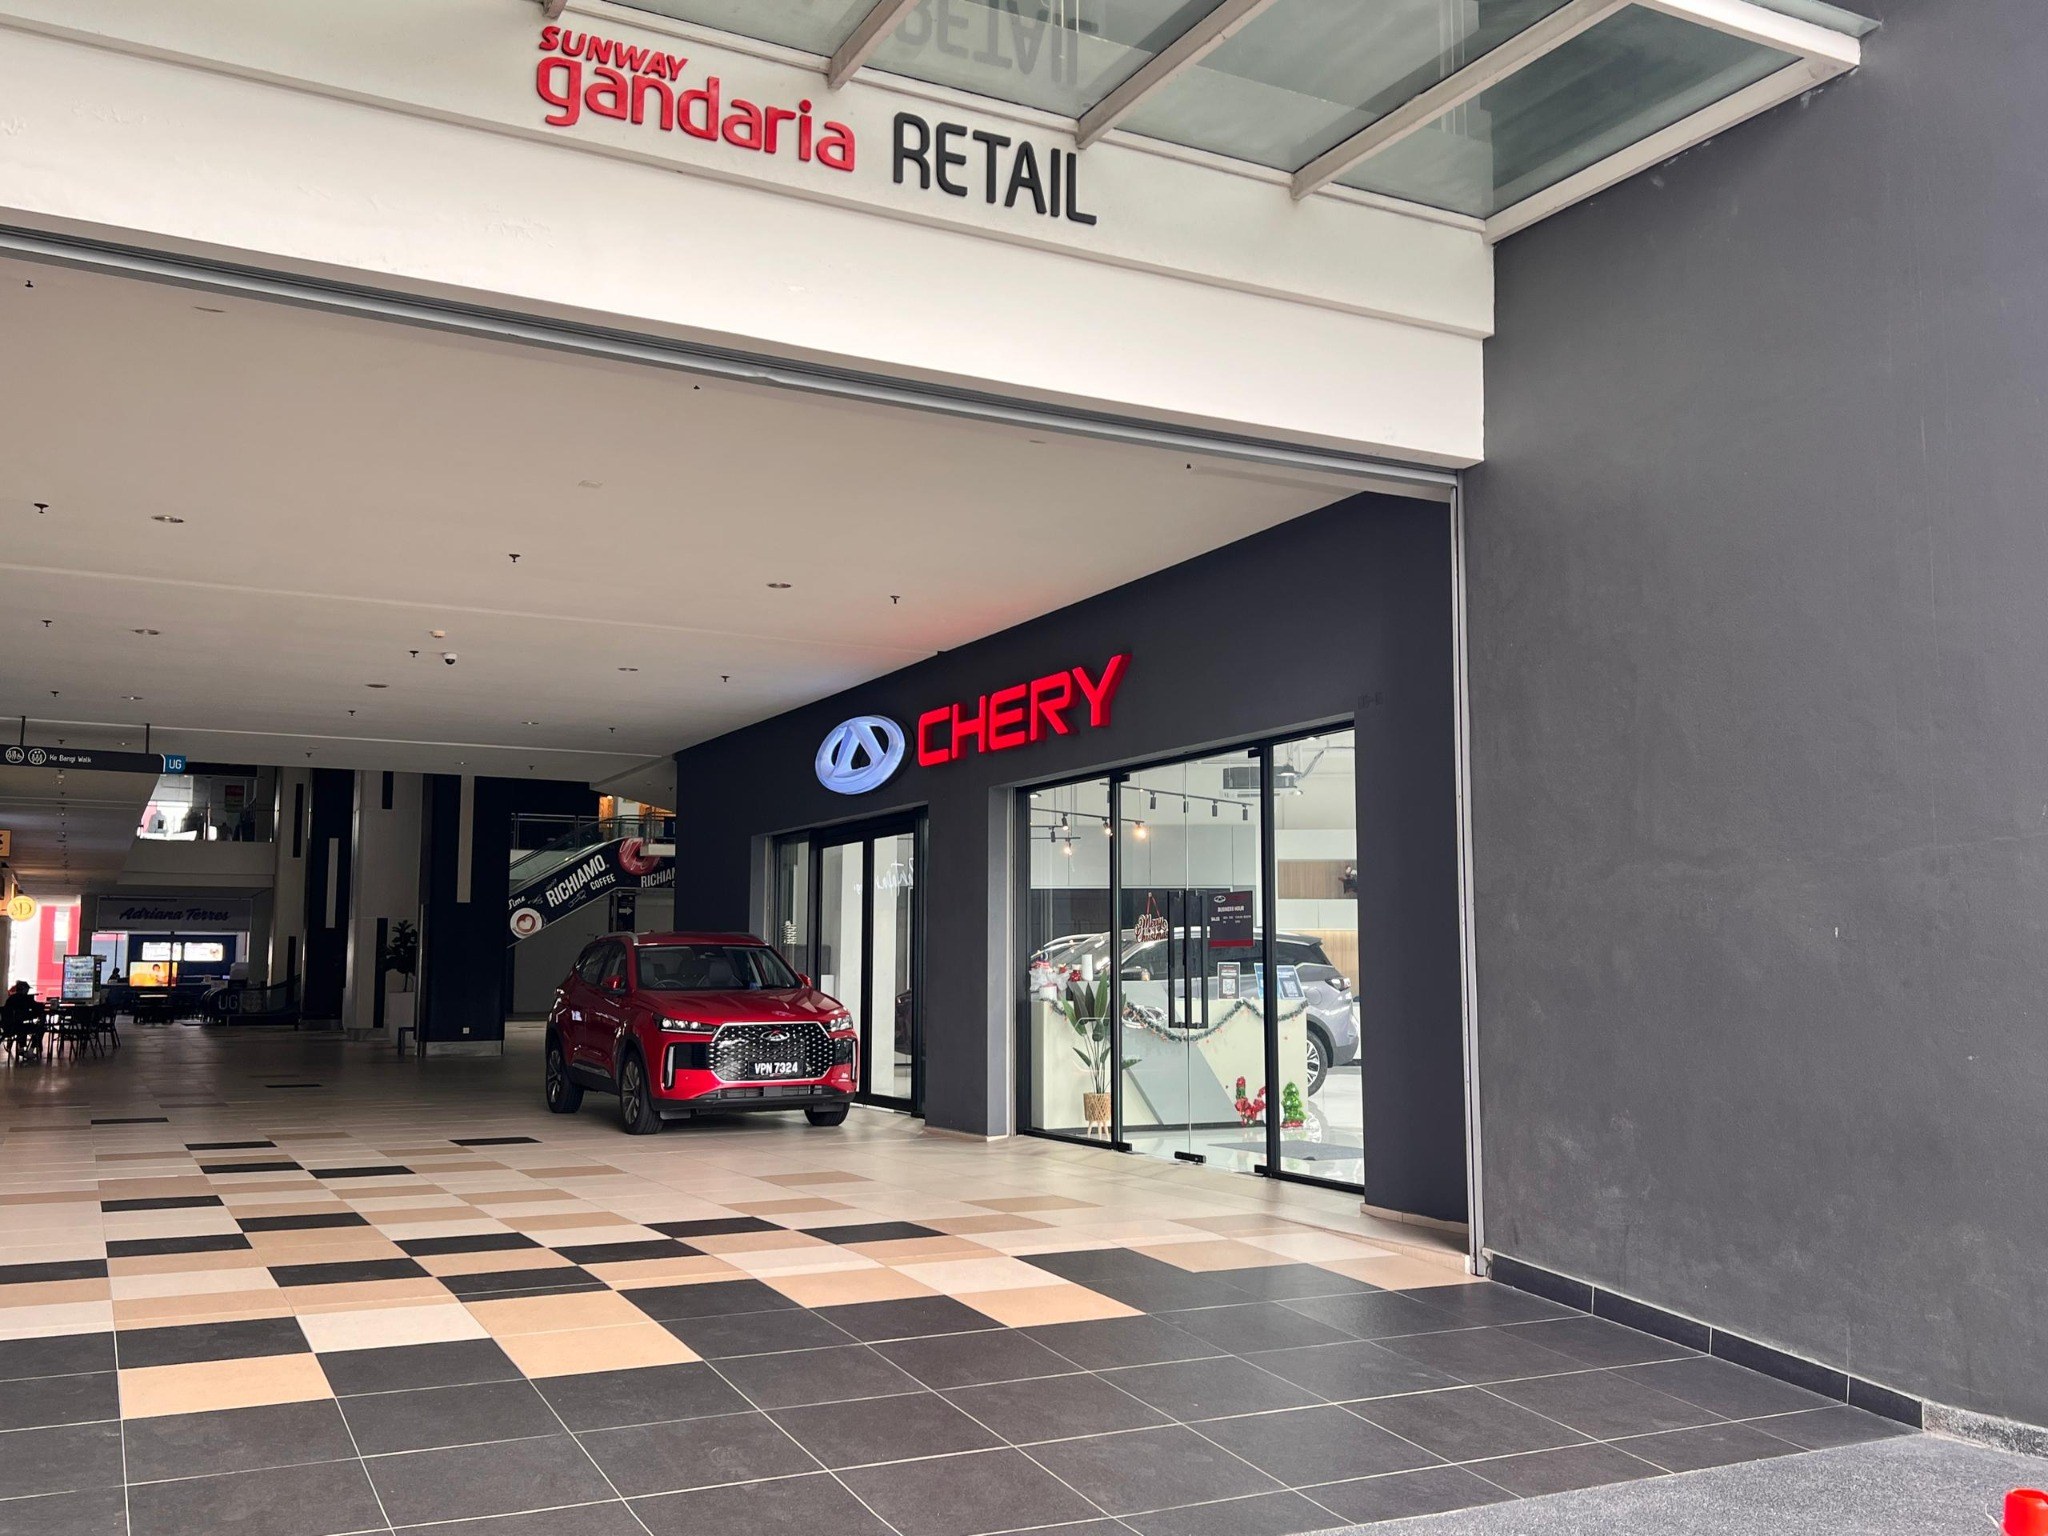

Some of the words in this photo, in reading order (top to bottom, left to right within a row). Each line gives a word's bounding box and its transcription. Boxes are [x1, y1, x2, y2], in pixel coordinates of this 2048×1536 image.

[539, 25, 688, 81] SUNWAY
[536, 55, 856, 172] gandaria
[893, 111, 1097, 226] RETAIL
[918, 653, 1132, 767] CHERY
[77, 755, 92, 763] Walk
[168, 759, 182, 770] UG
[545, 854, 607, 908] RICHIAMO
[590, 873, 616, 890] COFFEE
[119, 907, 183, 921] Adriana
[754, 1062, 773, 1075] VPN
[773, 1061, 798, 1074] 7324
